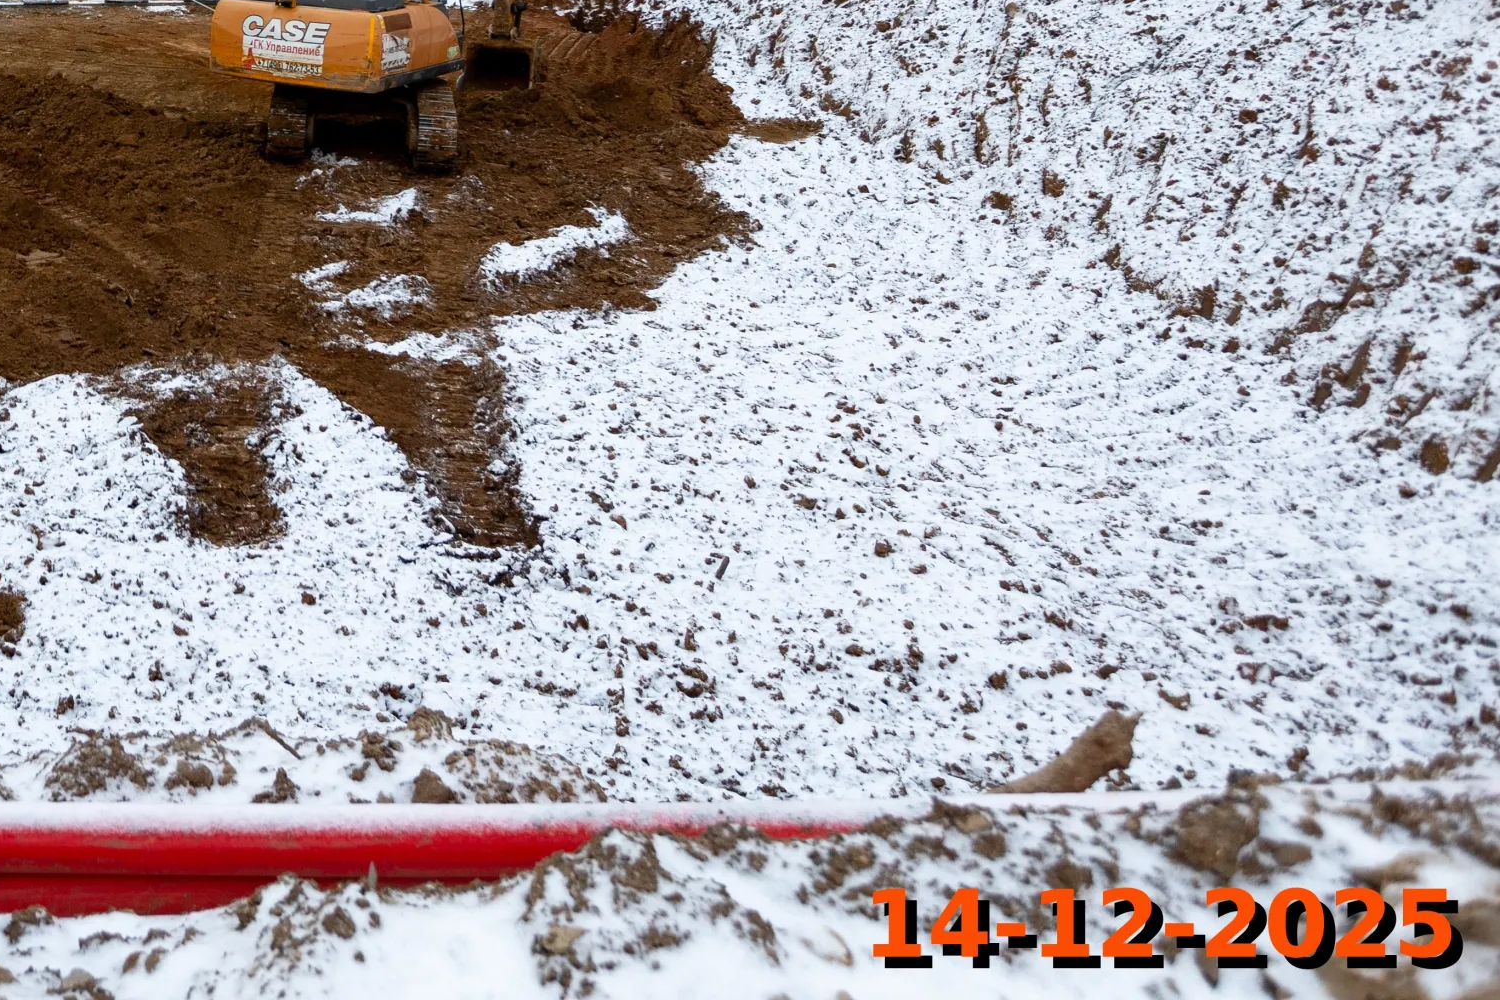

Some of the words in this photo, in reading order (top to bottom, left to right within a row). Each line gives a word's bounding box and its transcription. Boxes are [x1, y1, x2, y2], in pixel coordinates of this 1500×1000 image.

[242, 14, 331, 44] CASE
[253, 39, 264, 49] ГК
[266, 40, 320, 56] Управление
